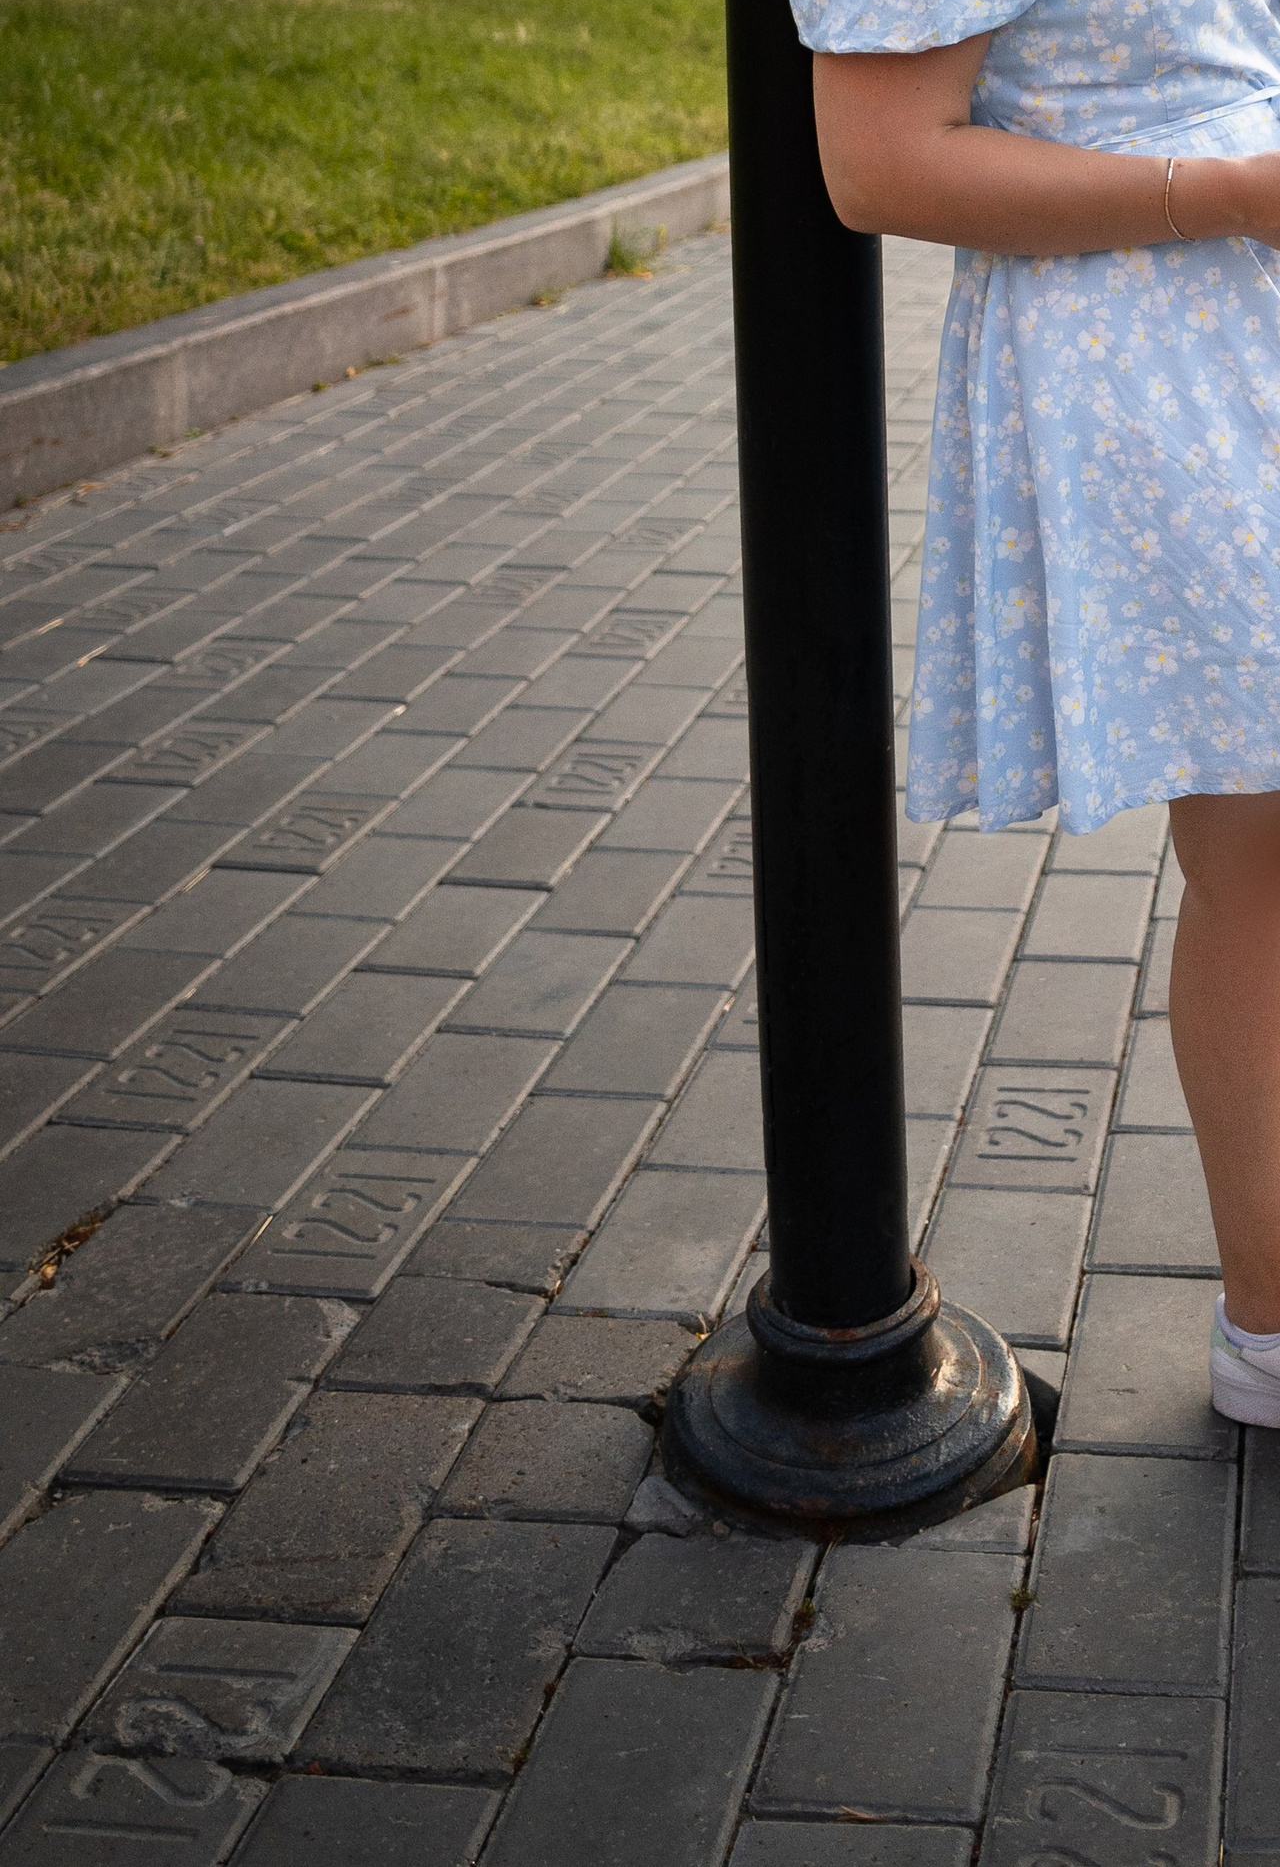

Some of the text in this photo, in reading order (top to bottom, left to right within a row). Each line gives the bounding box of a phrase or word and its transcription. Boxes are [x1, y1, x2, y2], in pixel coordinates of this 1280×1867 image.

[104, 1029, 262, 1101] 1221
[976, 1086, 1092, 1163] 1221
[267, 1171, 436, 1260] 1221
